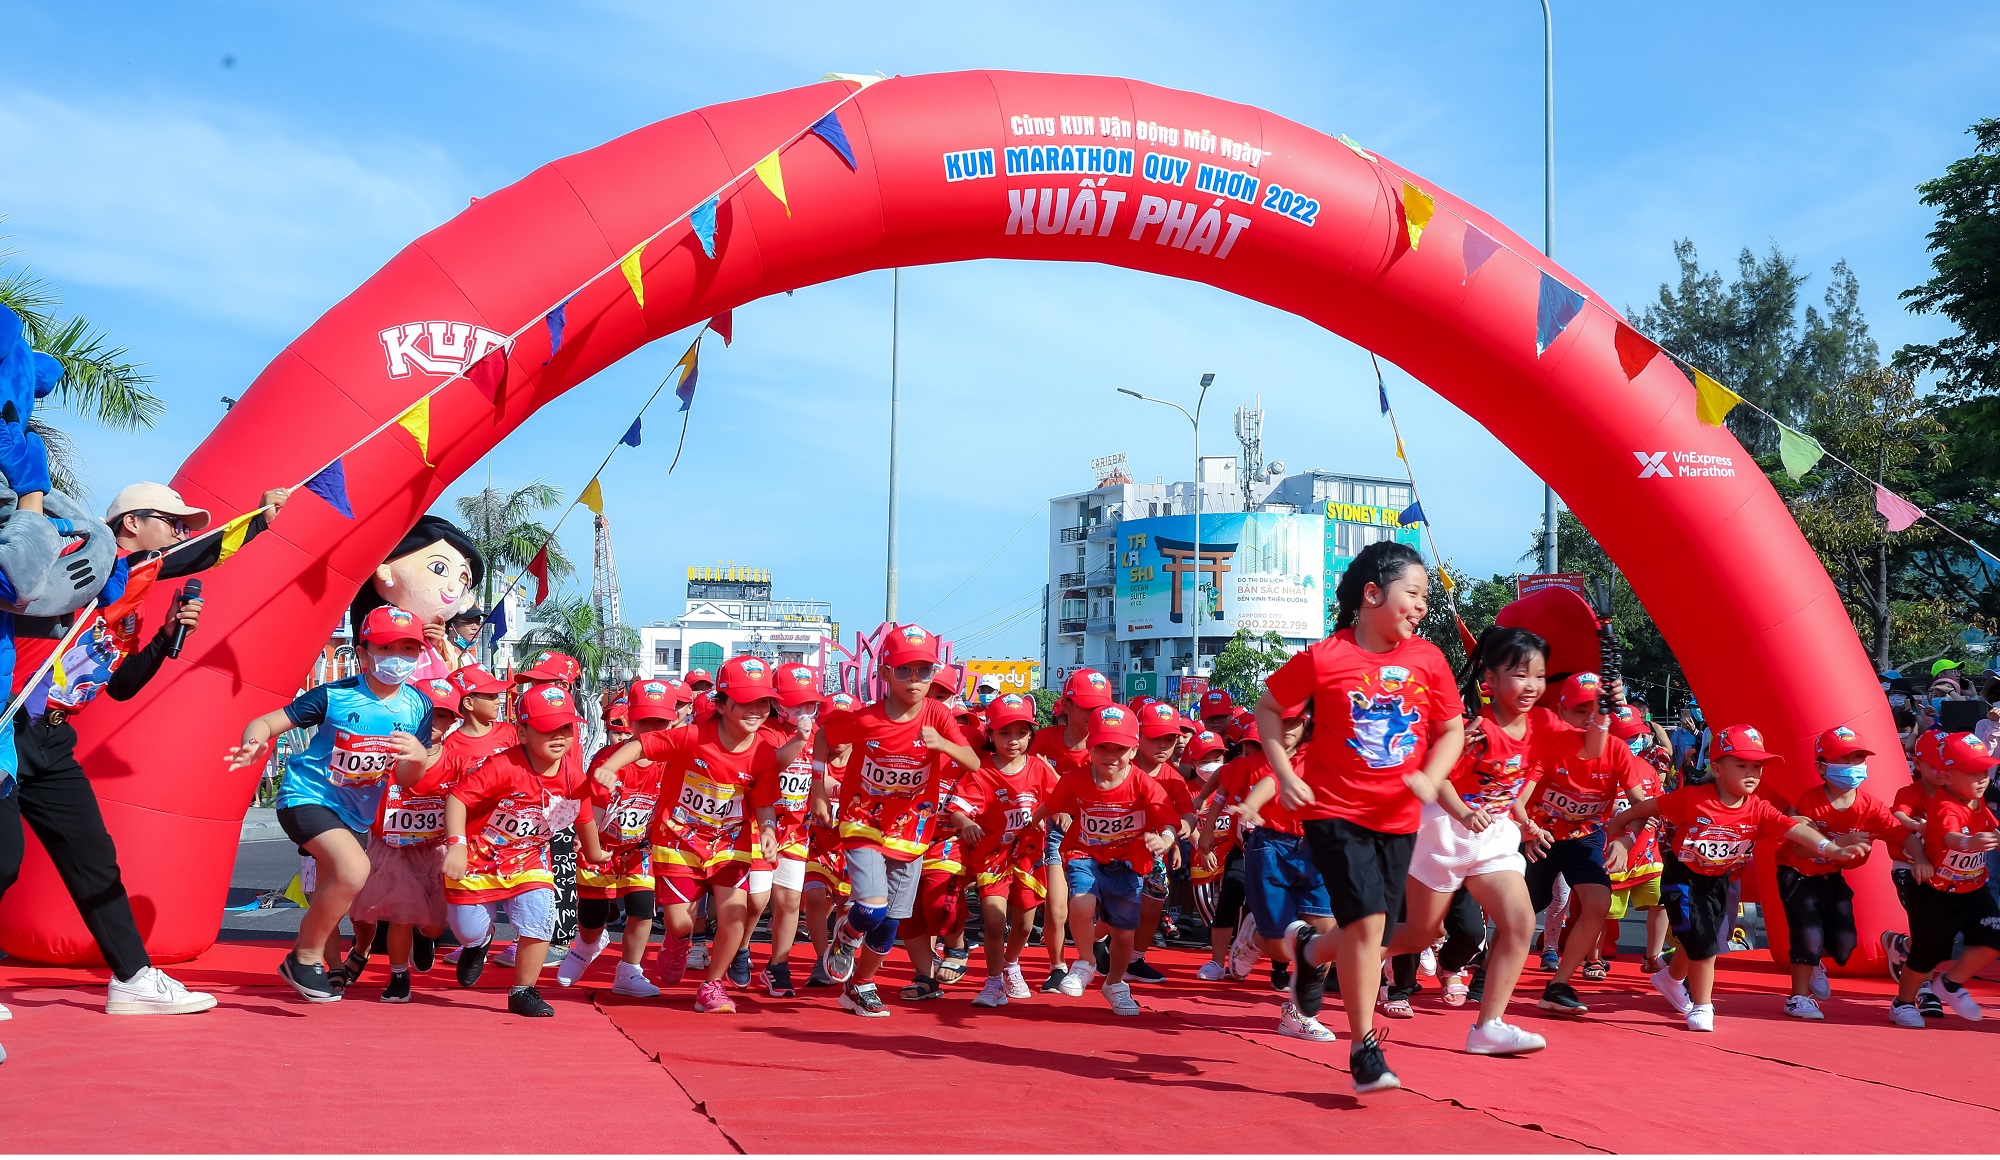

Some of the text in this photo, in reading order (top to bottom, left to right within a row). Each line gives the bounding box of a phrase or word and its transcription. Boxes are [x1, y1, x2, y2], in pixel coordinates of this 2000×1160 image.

[1011, 115, 1263, 167] Cùng KUN Vận Động Mỗi Ngày
[945, 147, 1321, 226] KUN MARATHON QUY NHƠN 2022
[1005, 177, 1251, 260] XUẤT PHÁT
[1672, 451, 1732, 466] VnExpress
[1678, 466, 1735, 477] Marathon
[1327, 502, 1377, 523] SYDNEY
[687, 567, 768, 582] MIRA HOTEL
[1130, 566, 1153, 582] SHI
[1130, 584, 1149, 592] OCEAN
[1238, 620, 1308, 630] 090.2222.799
[992, 669, 1025, 688] ody
[865, 761, 923, 785] 10386
[682, 788, 734, 818] 30340
[1547, 791, 1598, 815] 10381
[1082, 814, 1134, 834] 10282
